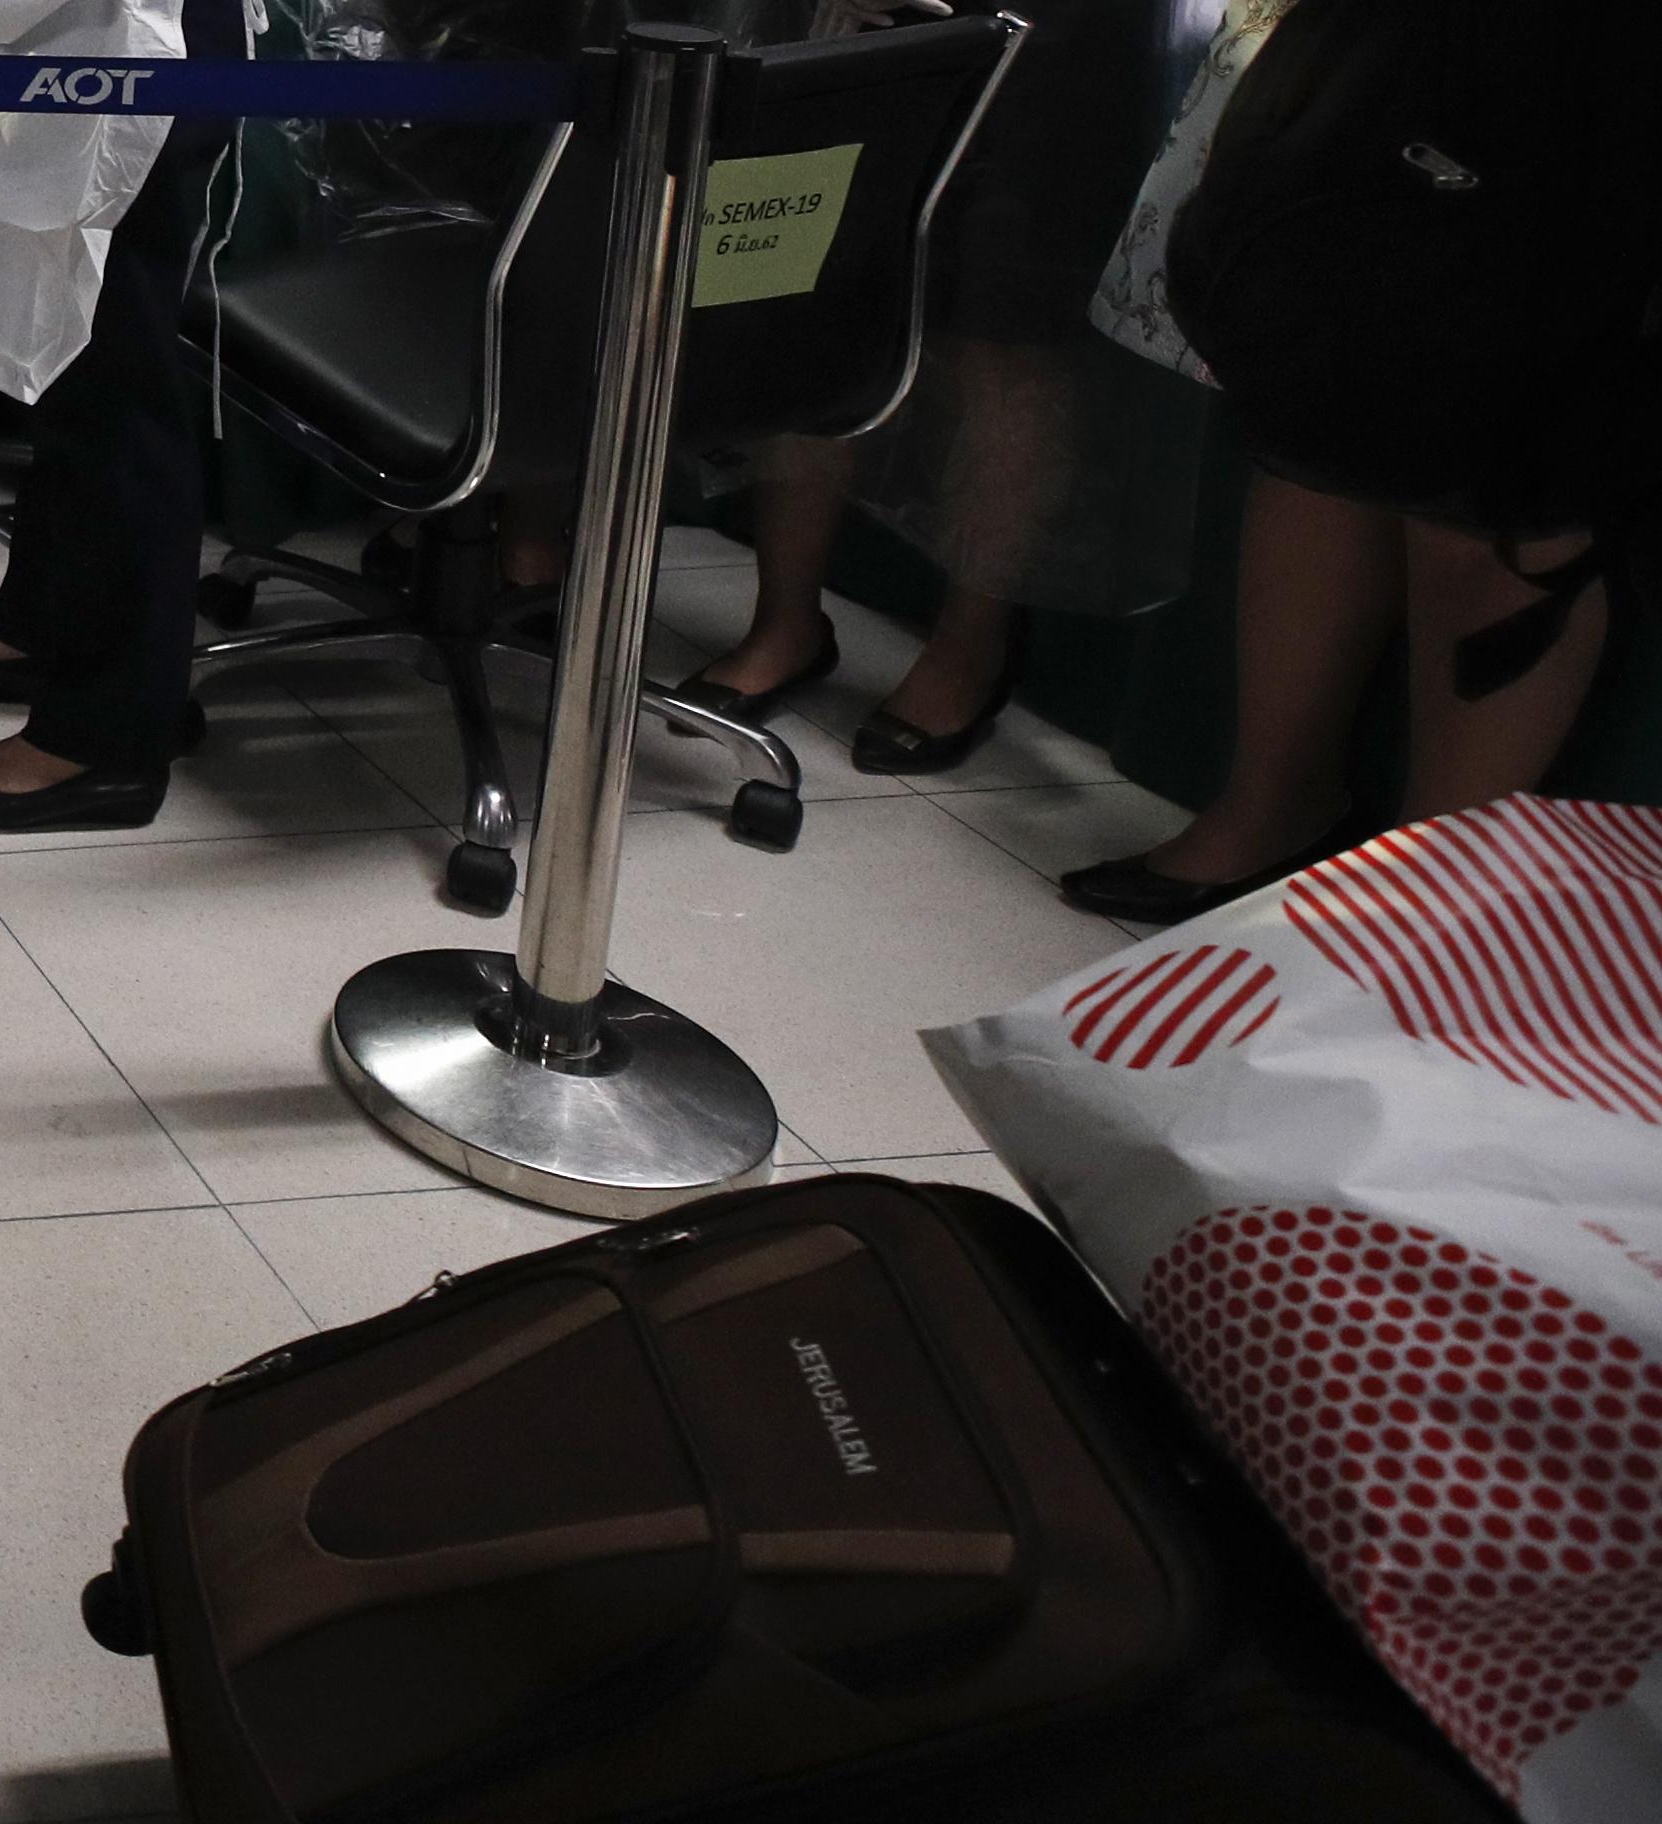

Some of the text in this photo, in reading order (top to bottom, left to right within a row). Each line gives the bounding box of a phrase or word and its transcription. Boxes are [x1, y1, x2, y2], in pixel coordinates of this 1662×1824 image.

[18, 67, 156, 106] AOT
[717, 192, 823, 225] SEMEX-19
[716, 234, 733, 256] 6
[788, 1336, 879, 1476] JERUSALEM
